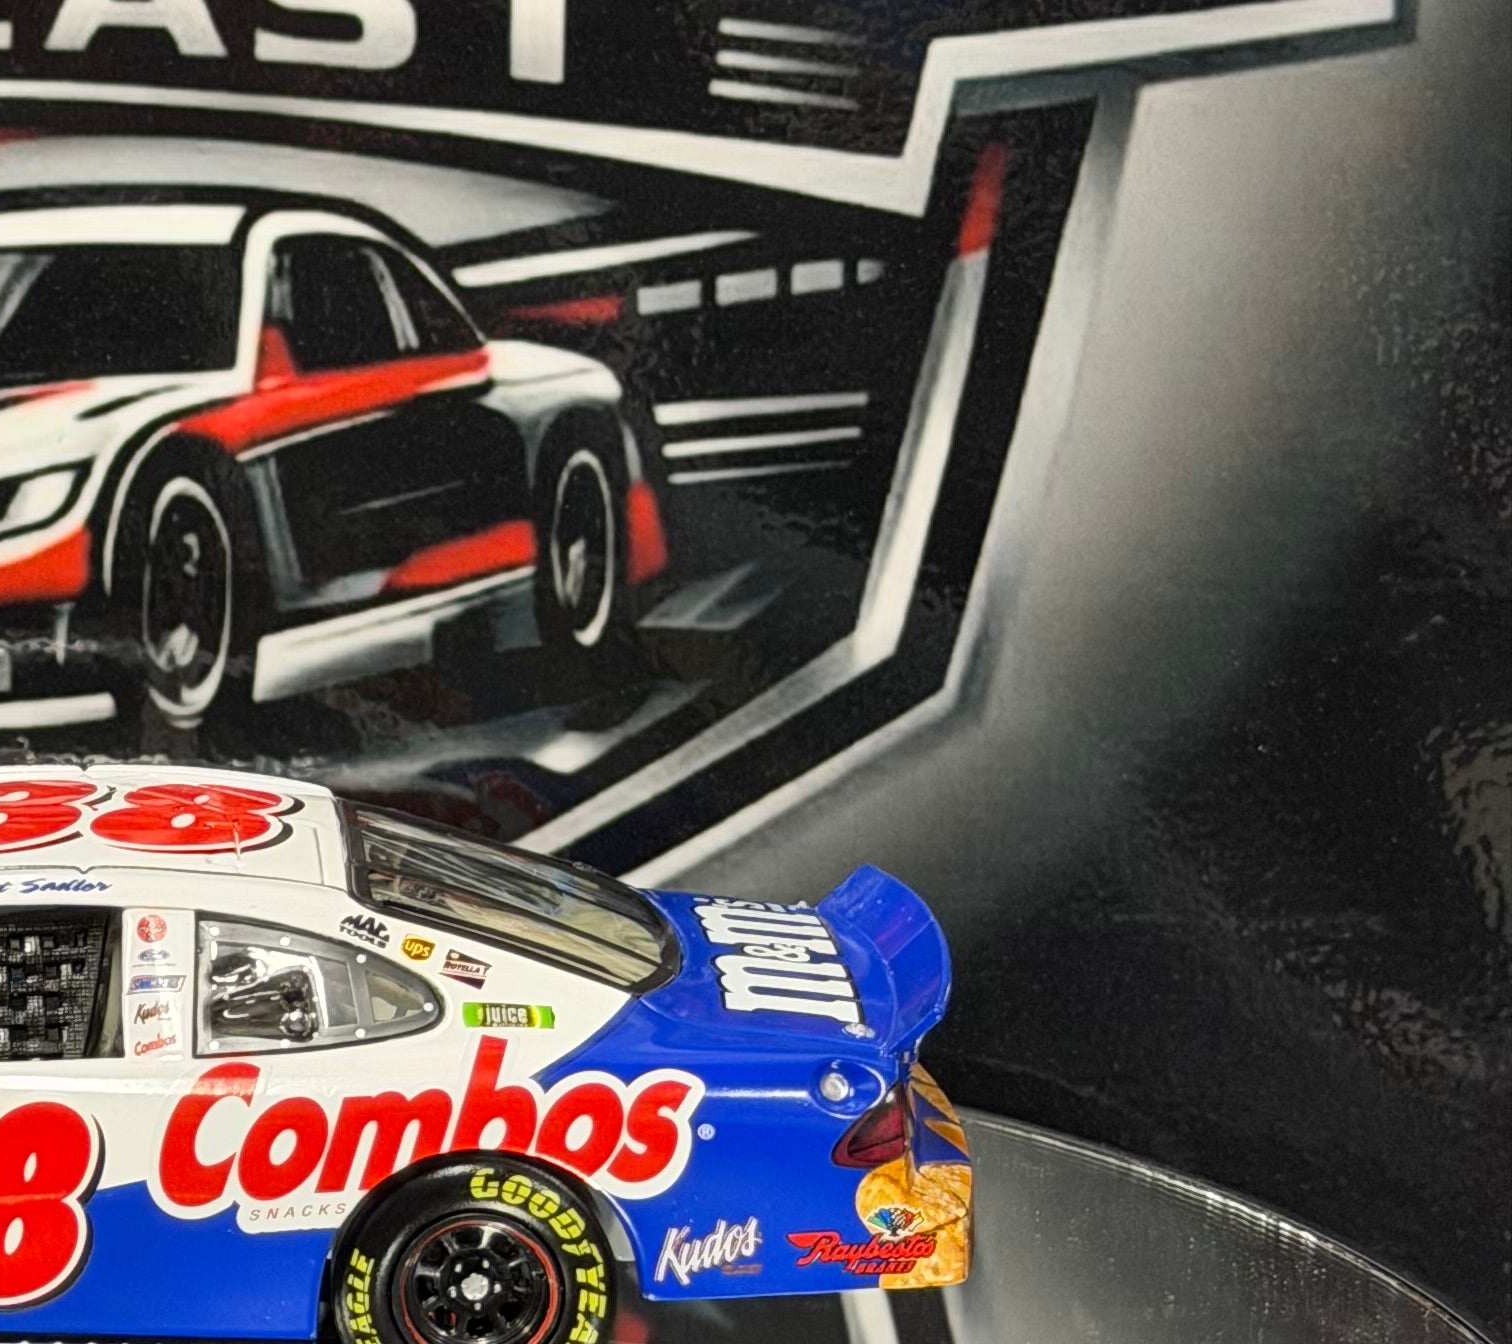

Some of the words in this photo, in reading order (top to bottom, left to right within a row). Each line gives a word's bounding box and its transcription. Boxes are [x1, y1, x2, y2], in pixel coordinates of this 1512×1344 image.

[404, 940, 431, 957] ups
[134, 1033, 177, 1057] Combos
[159, 1034, 693, 1207] Combos
[248, 1201, 348, 1222] SNACKS
[654, 1216, 763, 1286] Kudos
